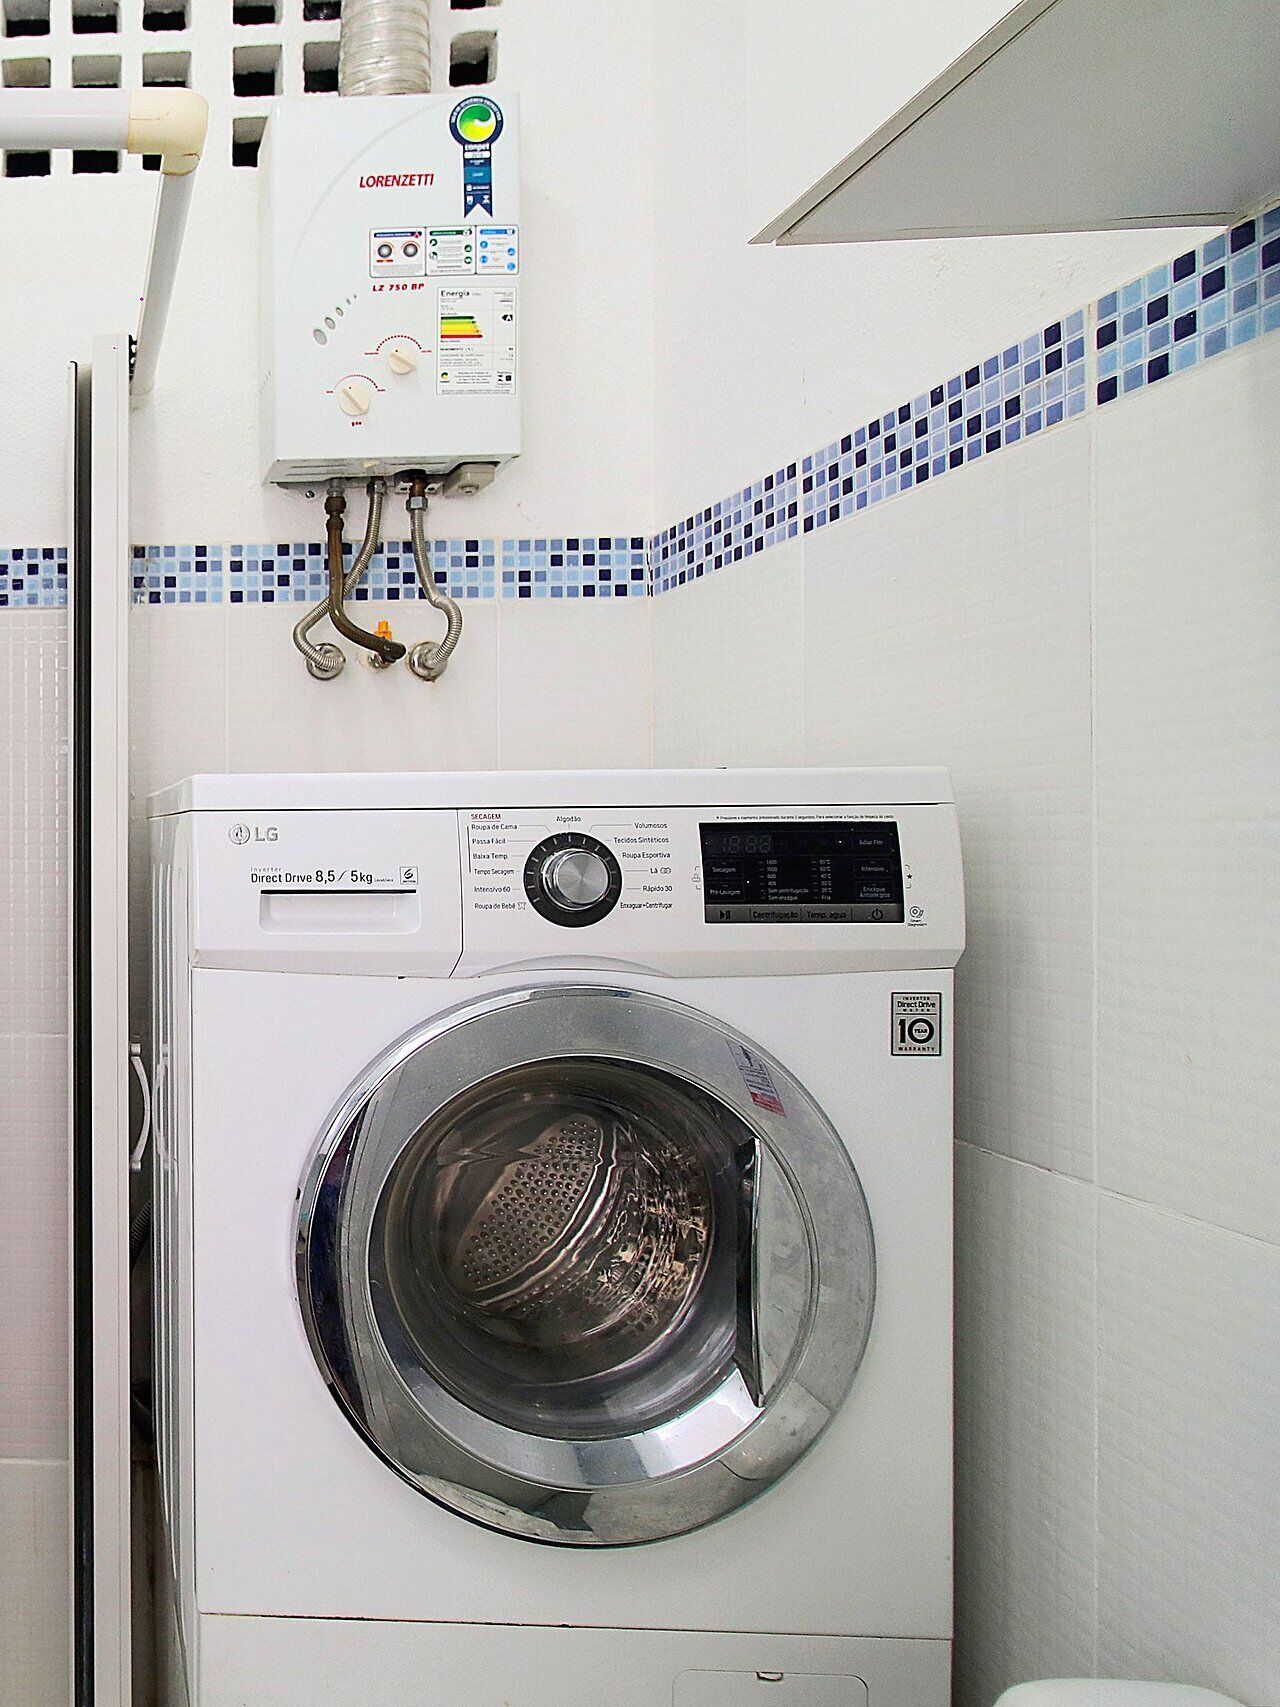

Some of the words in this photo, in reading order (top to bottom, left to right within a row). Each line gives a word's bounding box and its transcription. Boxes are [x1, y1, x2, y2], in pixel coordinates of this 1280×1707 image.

[359, 173, 435, 188] LORENZETTI
[441, 290, 469, 298] Energia
[255, 826, 278, 842] LG
[251, 873, 282, 883] Direct
[286, 872, 312, 883] Drive
[315, 870, 335, 884] 8,5
[350, 870, 373, 884] 5kg
[898, 1018, 934, 1044] 10
